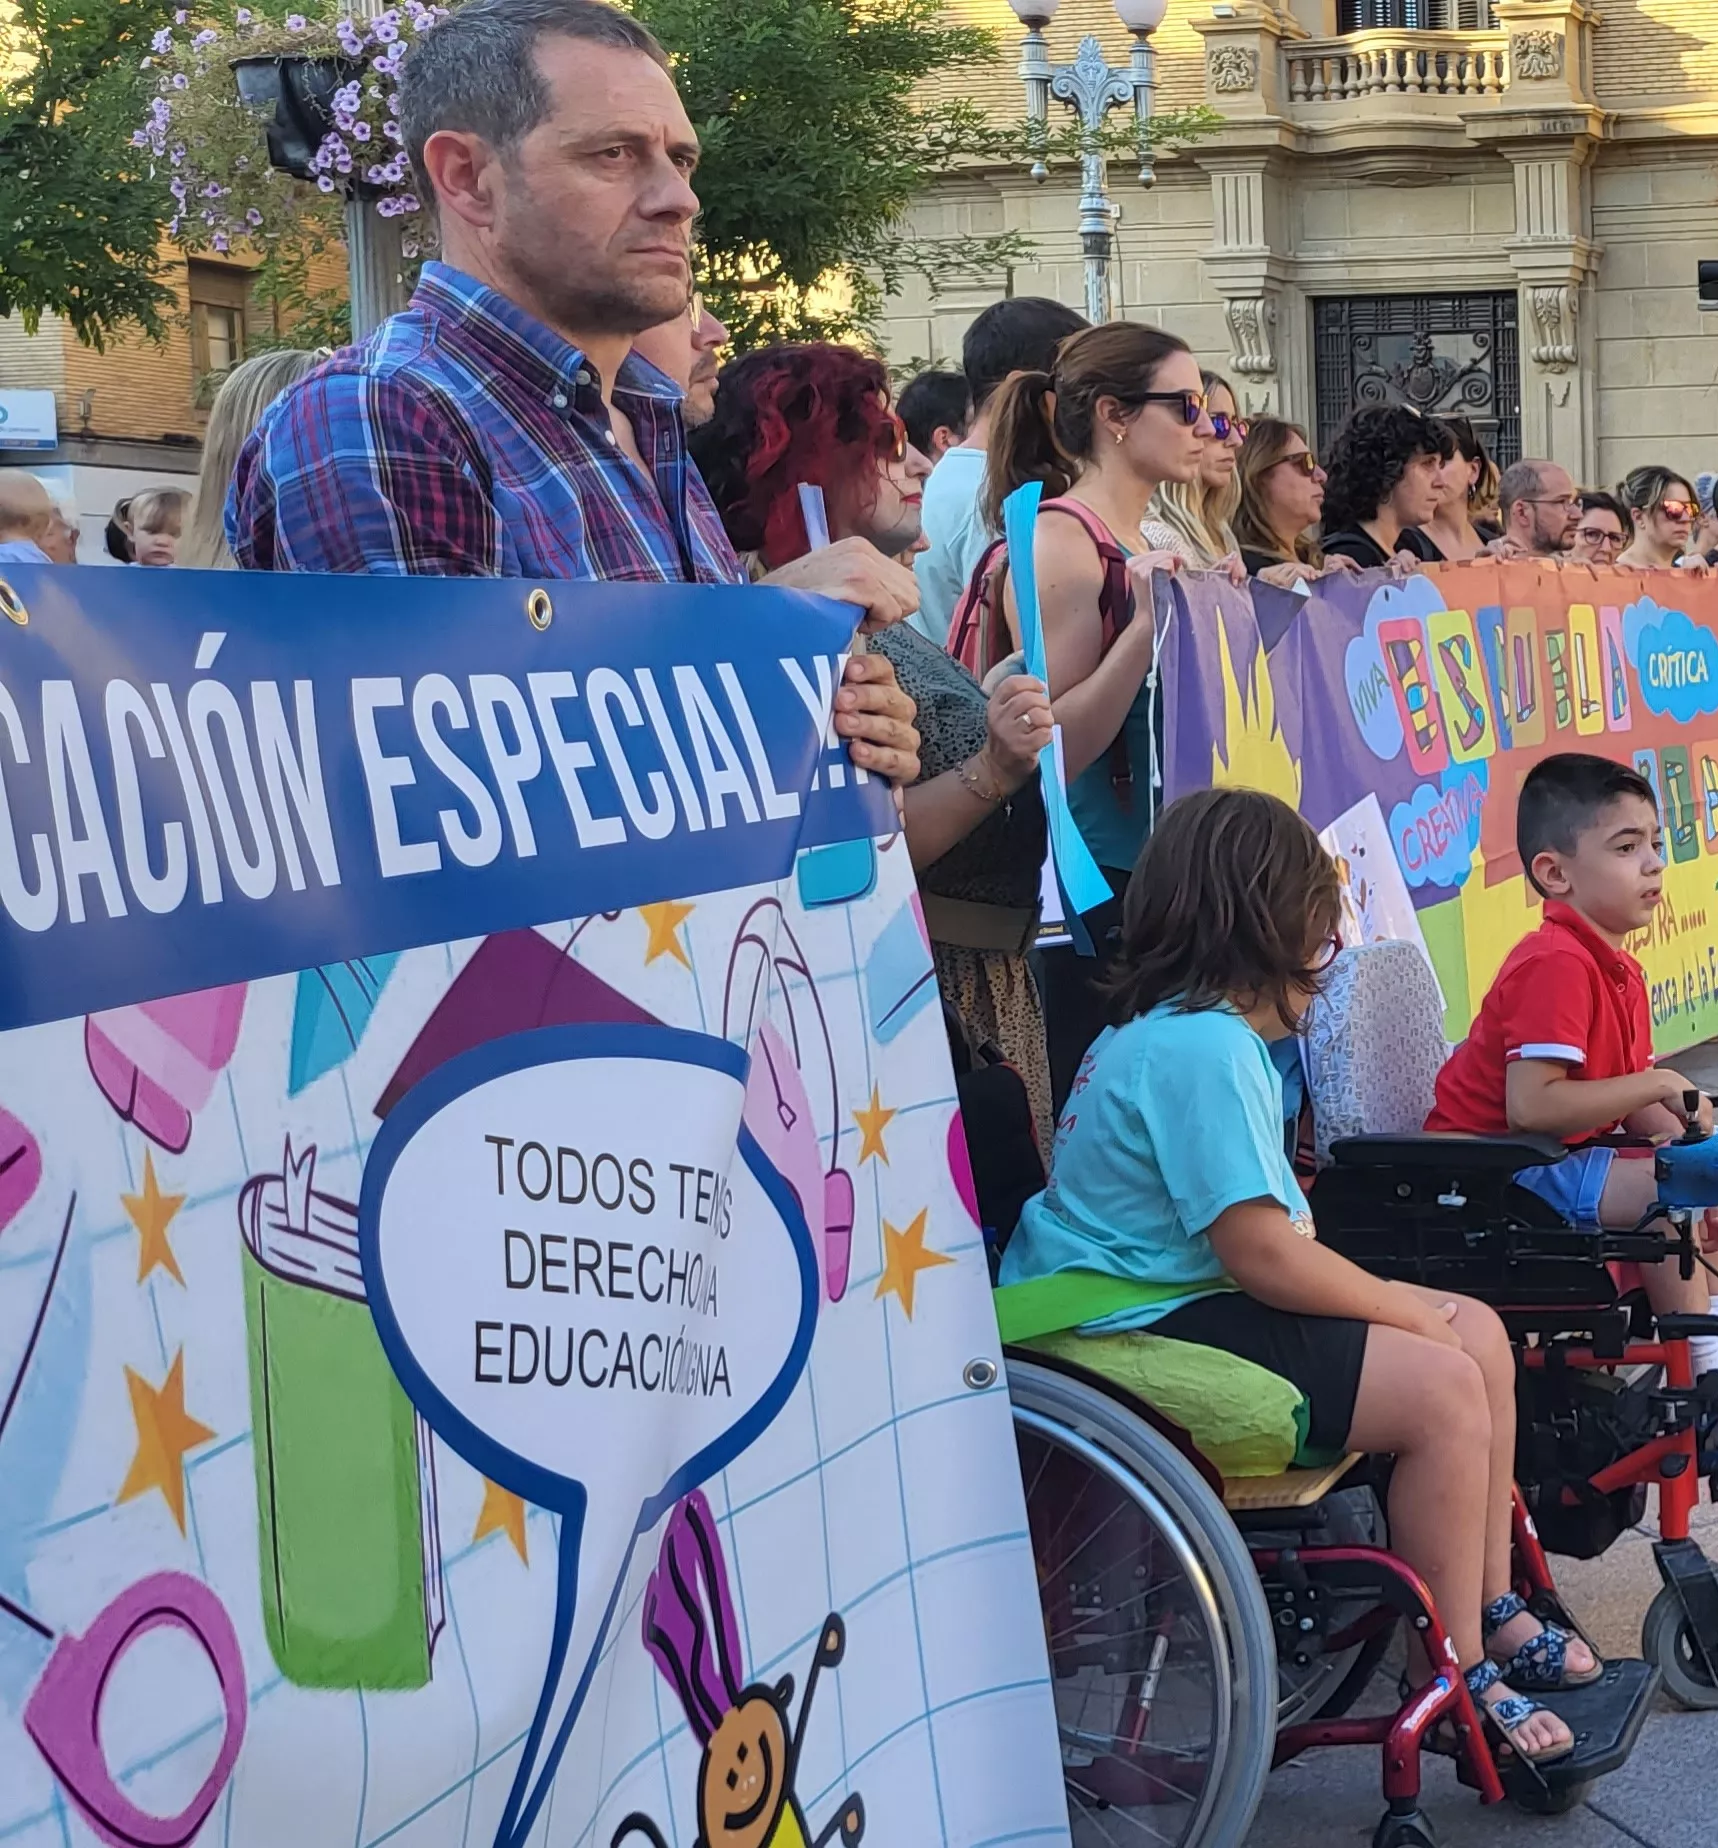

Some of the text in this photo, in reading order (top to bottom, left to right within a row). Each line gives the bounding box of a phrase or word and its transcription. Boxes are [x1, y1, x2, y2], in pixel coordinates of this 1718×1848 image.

[1648, 646, 1709, 689] CRÍTICA
[351, 662, 801, 879] ESPECIAL
[1402, 771, 1488, 870] CREATIVA
[1647, 972, 1678, 1027] ensa
[485, 1134, 656, 1215] TODOS
[505, 1229, 704, 1309] DERECHO
